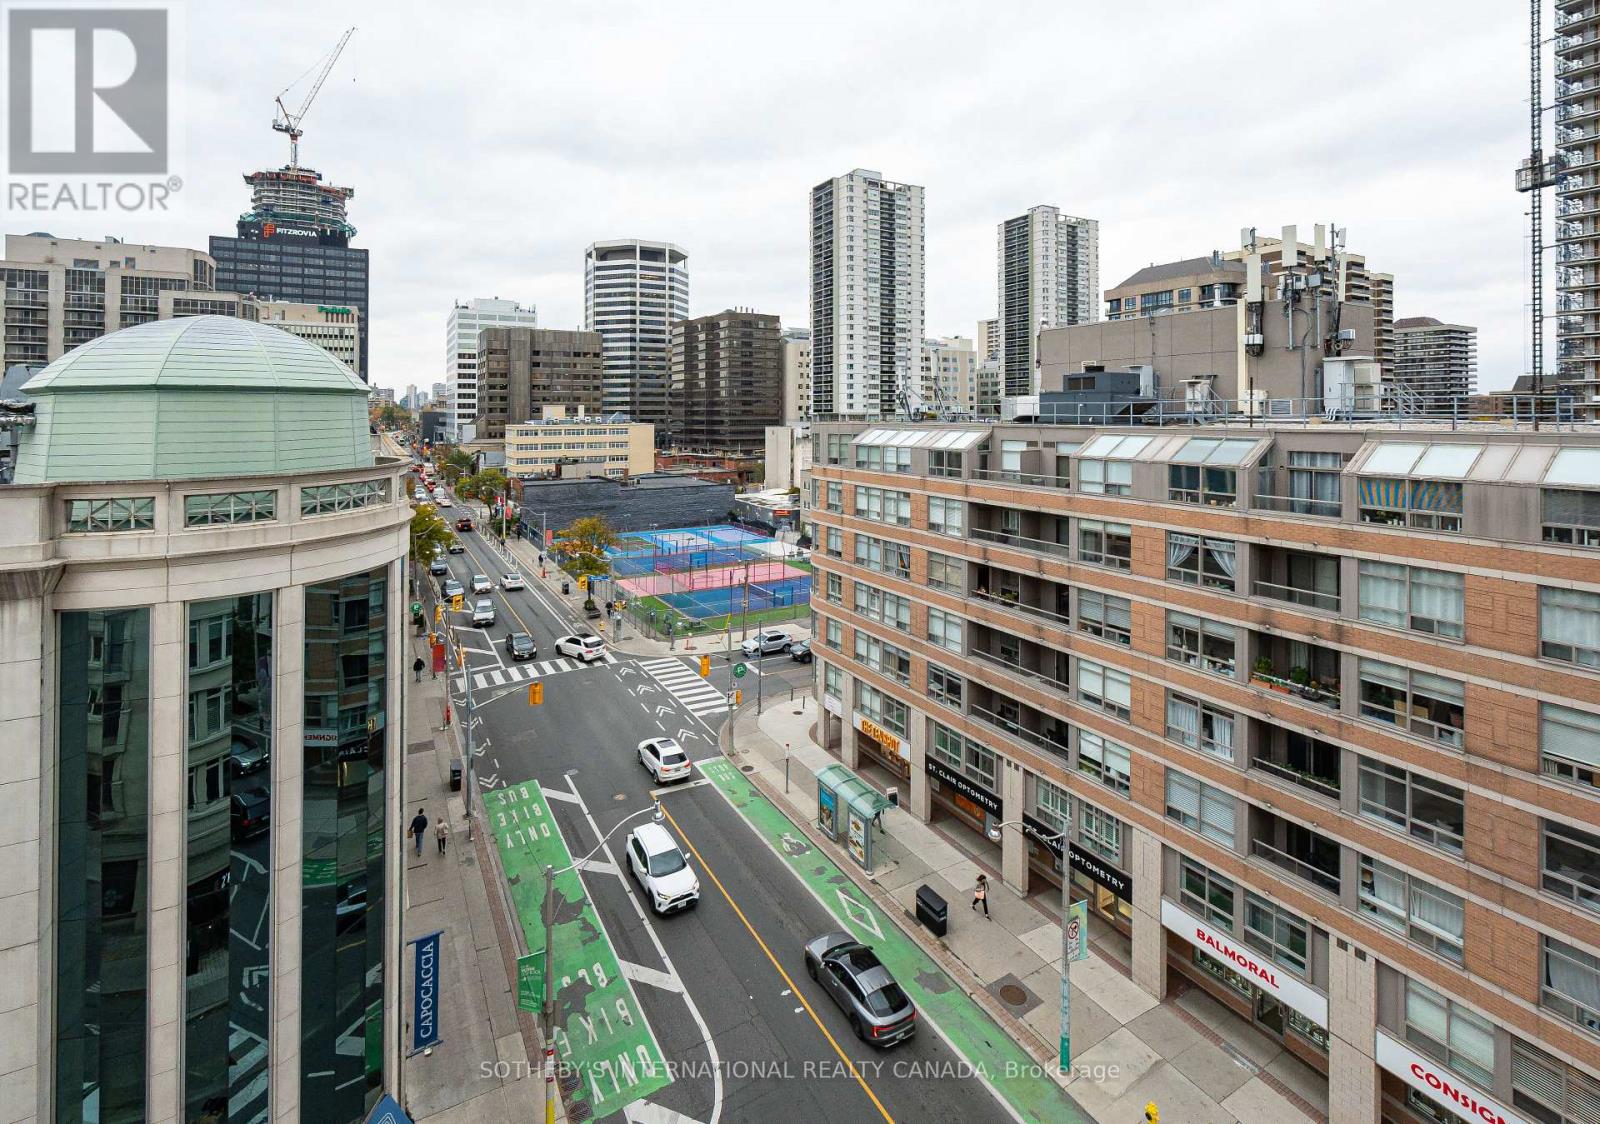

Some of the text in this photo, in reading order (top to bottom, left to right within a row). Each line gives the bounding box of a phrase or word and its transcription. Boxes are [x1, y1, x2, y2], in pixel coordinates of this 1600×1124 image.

[276, 228, 317, 237] FITZROVIA
[498, 786, 529, 805] BUS
[939, 769, 957, 785] CLAIR
[957, 782, 998, 810] OPTOMETRY
[497, 803, 542, 827] BIKE
[506, 822, 551, 849] ONLY
[1068, 850, 1125, 890] OPTOMETRY
[1196, 928, 1279, 989] BALMORAL
[420, 941, 434, 1039] CAPOCACCIA
[587, 1044, 656, 1105] ONLY
